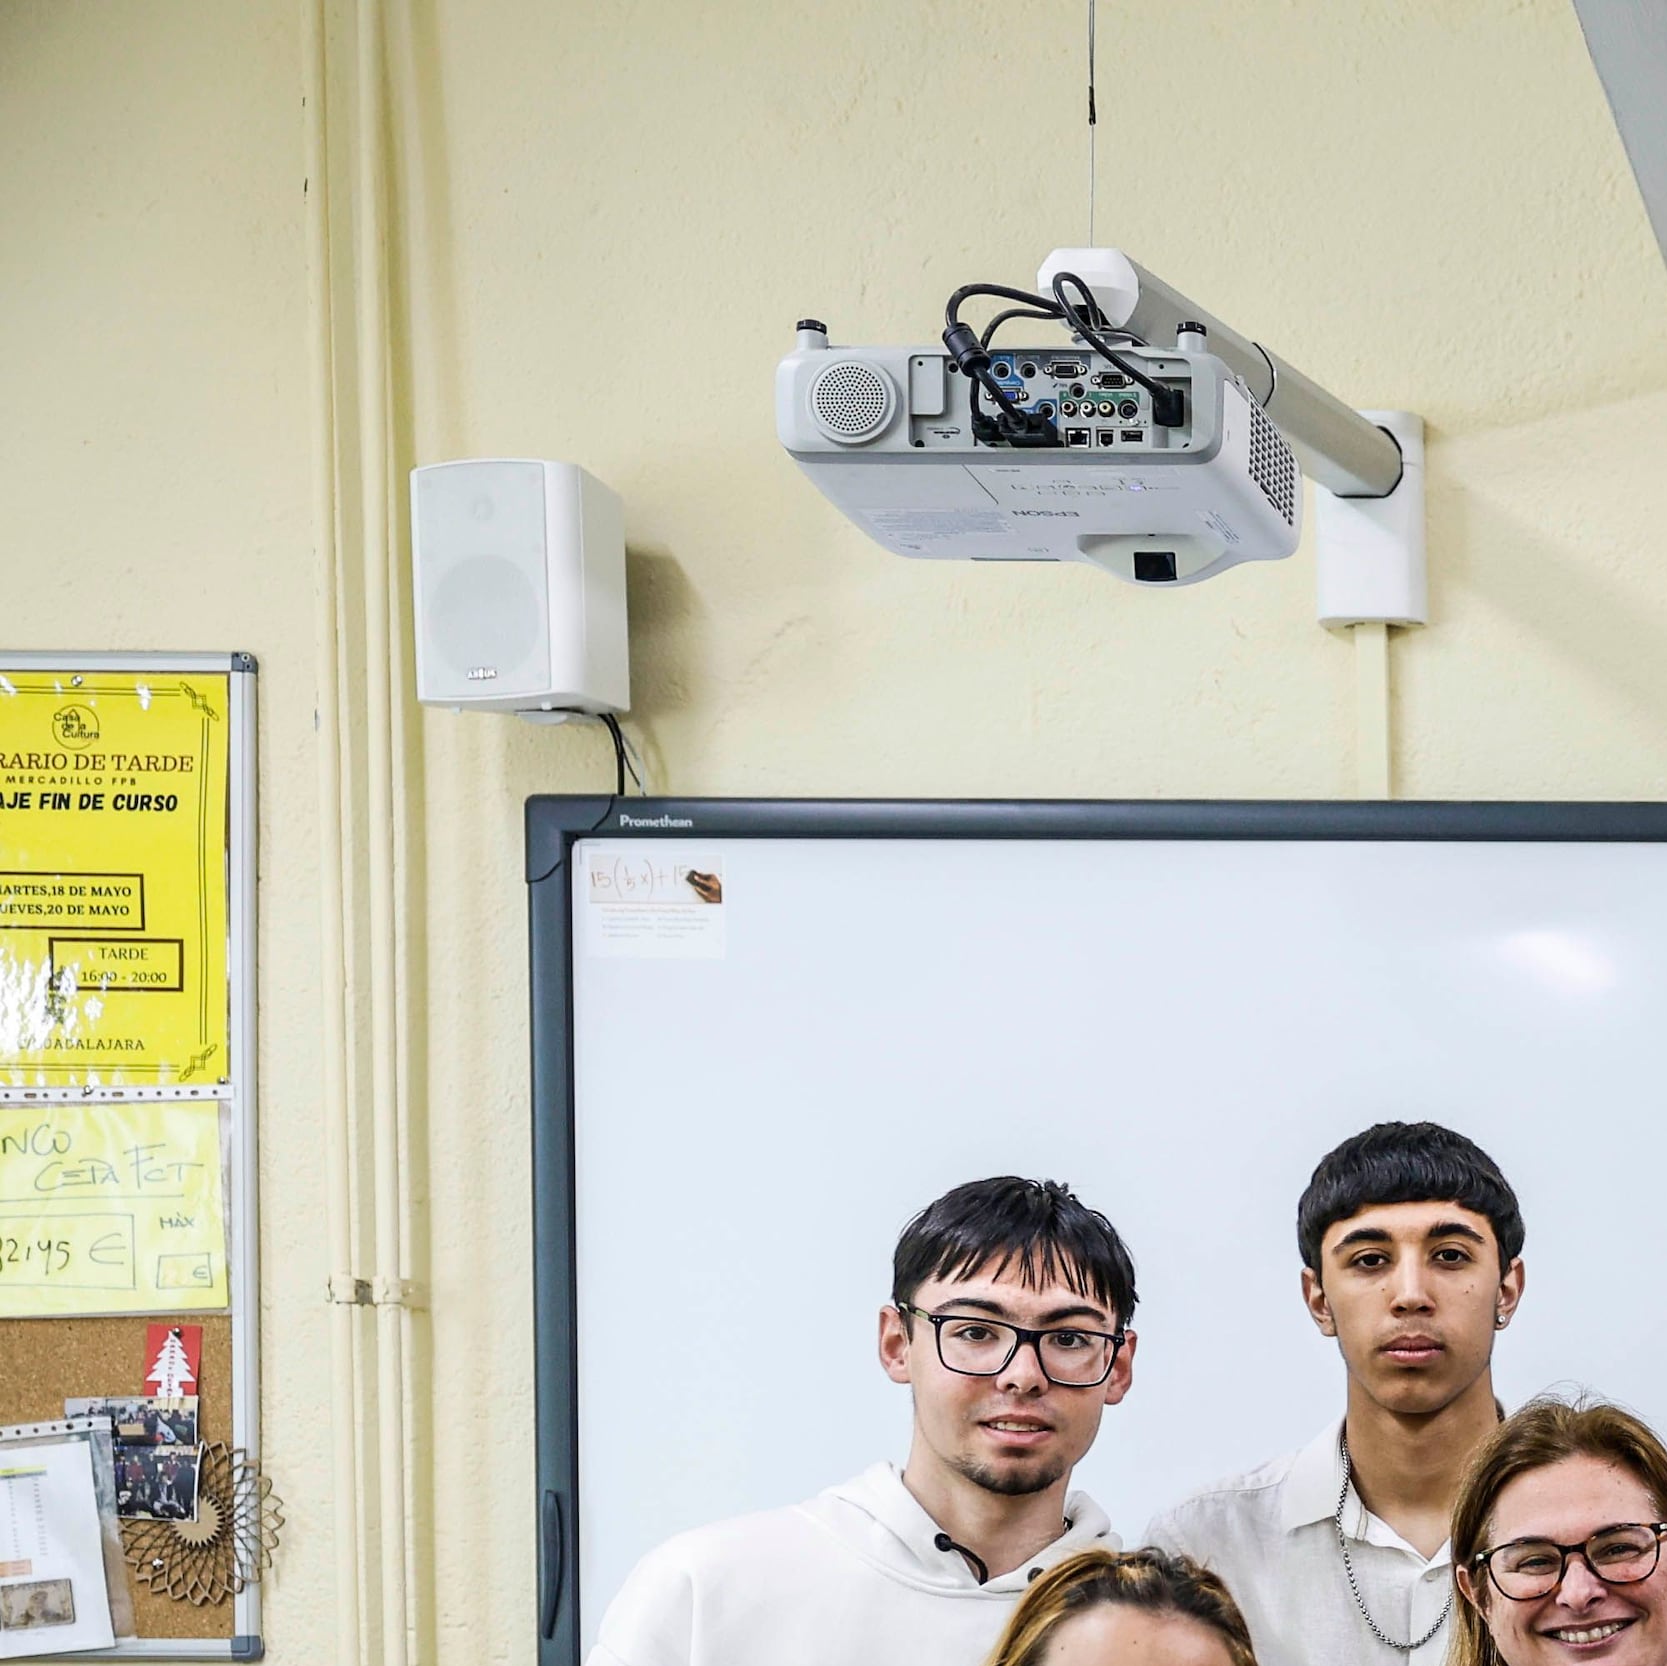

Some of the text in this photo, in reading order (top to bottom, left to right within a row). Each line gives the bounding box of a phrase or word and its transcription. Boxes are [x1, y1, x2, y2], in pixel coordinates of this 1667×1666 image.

[1012, 509, 1080, 518] EPSON
[74, 753, 106, 771] DE
[111, 754, 194, 773] TARDE
[5, 775, 137, 786] MERCADILLO FPB
[39, 792, 71, 811] FIN
[78, 793, 105, 811] DE
[112, 793, 178, 812] CURSO
[619, 814, 694, 829] Promethean
[69, 885, 88, 897] DE
[91, 886, 132, 898] MAYO
[67, 905, 86, 916] DE
[88, 905, 130, 916] MAYO
[98, 946, 150, 961] TARDE
[131, 971, 168, 984] 20:00
